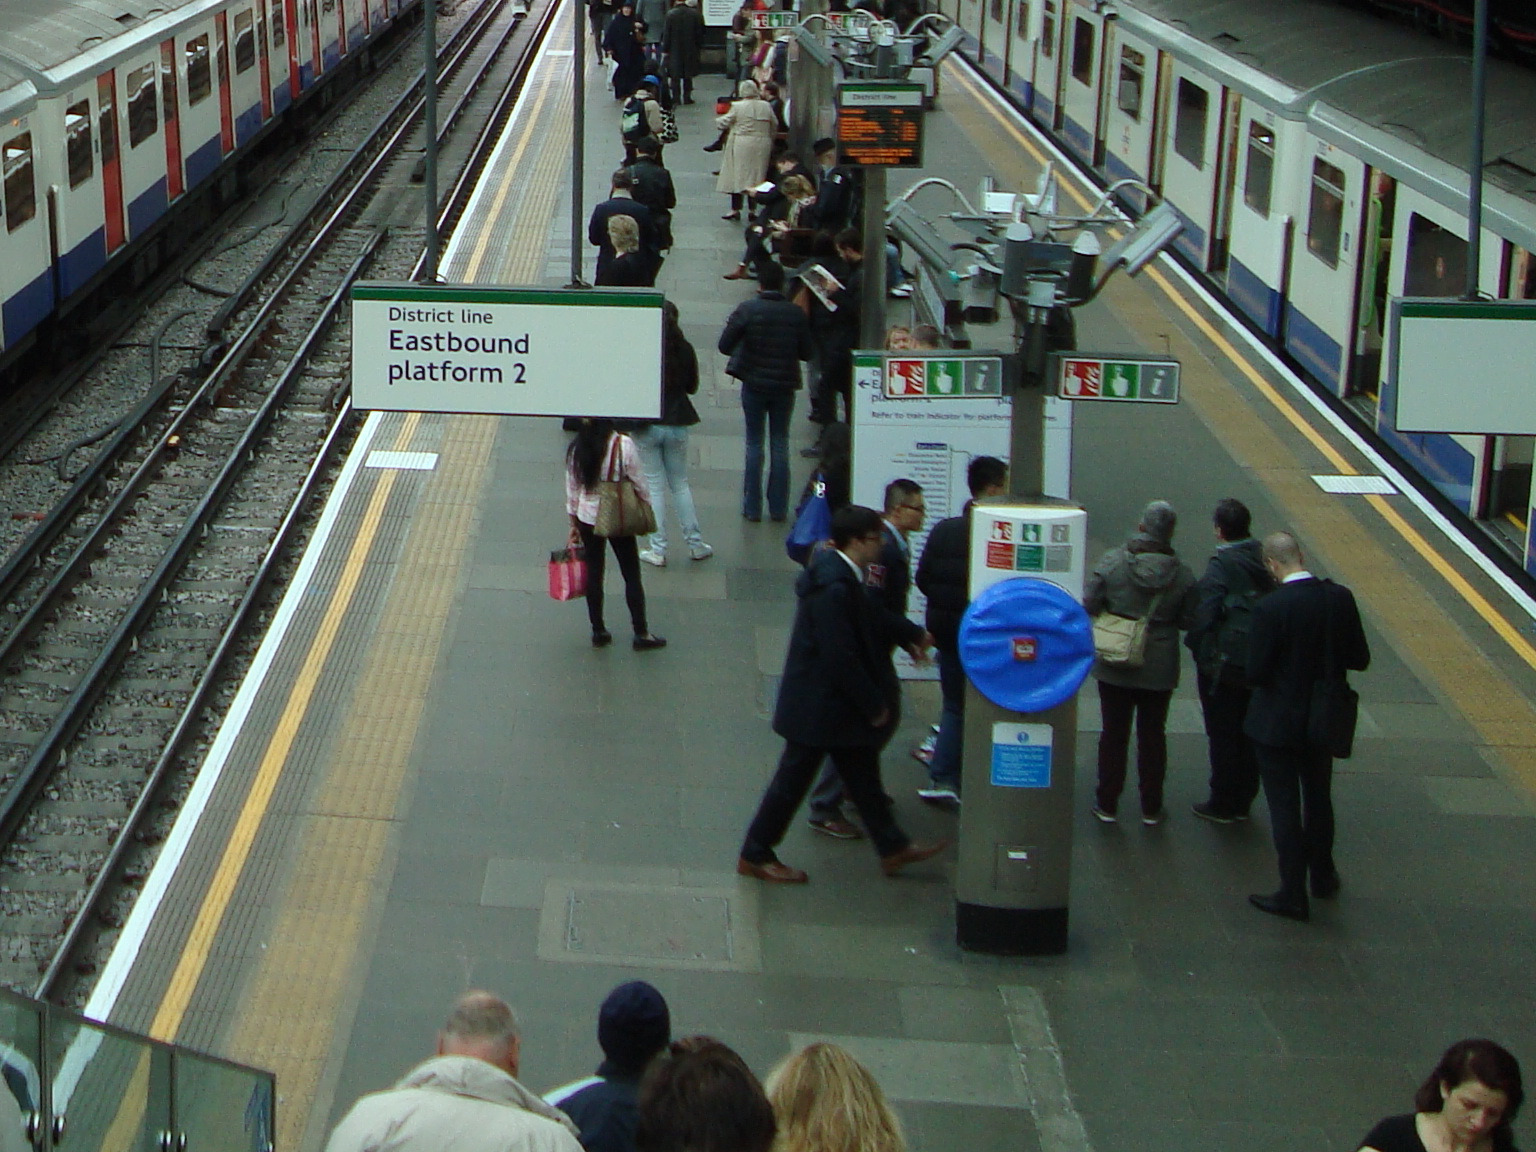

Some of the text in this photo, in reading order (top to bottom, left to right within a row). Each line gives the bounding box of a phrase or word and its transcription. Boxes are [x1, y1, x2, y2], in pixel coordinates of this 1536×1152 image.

[389, 307, 493, 324] District line
[389, 329, 529, 354] Eastbound
[389, 360, 526, 385] platform 2
[927, 412, 960, 420] indicator
